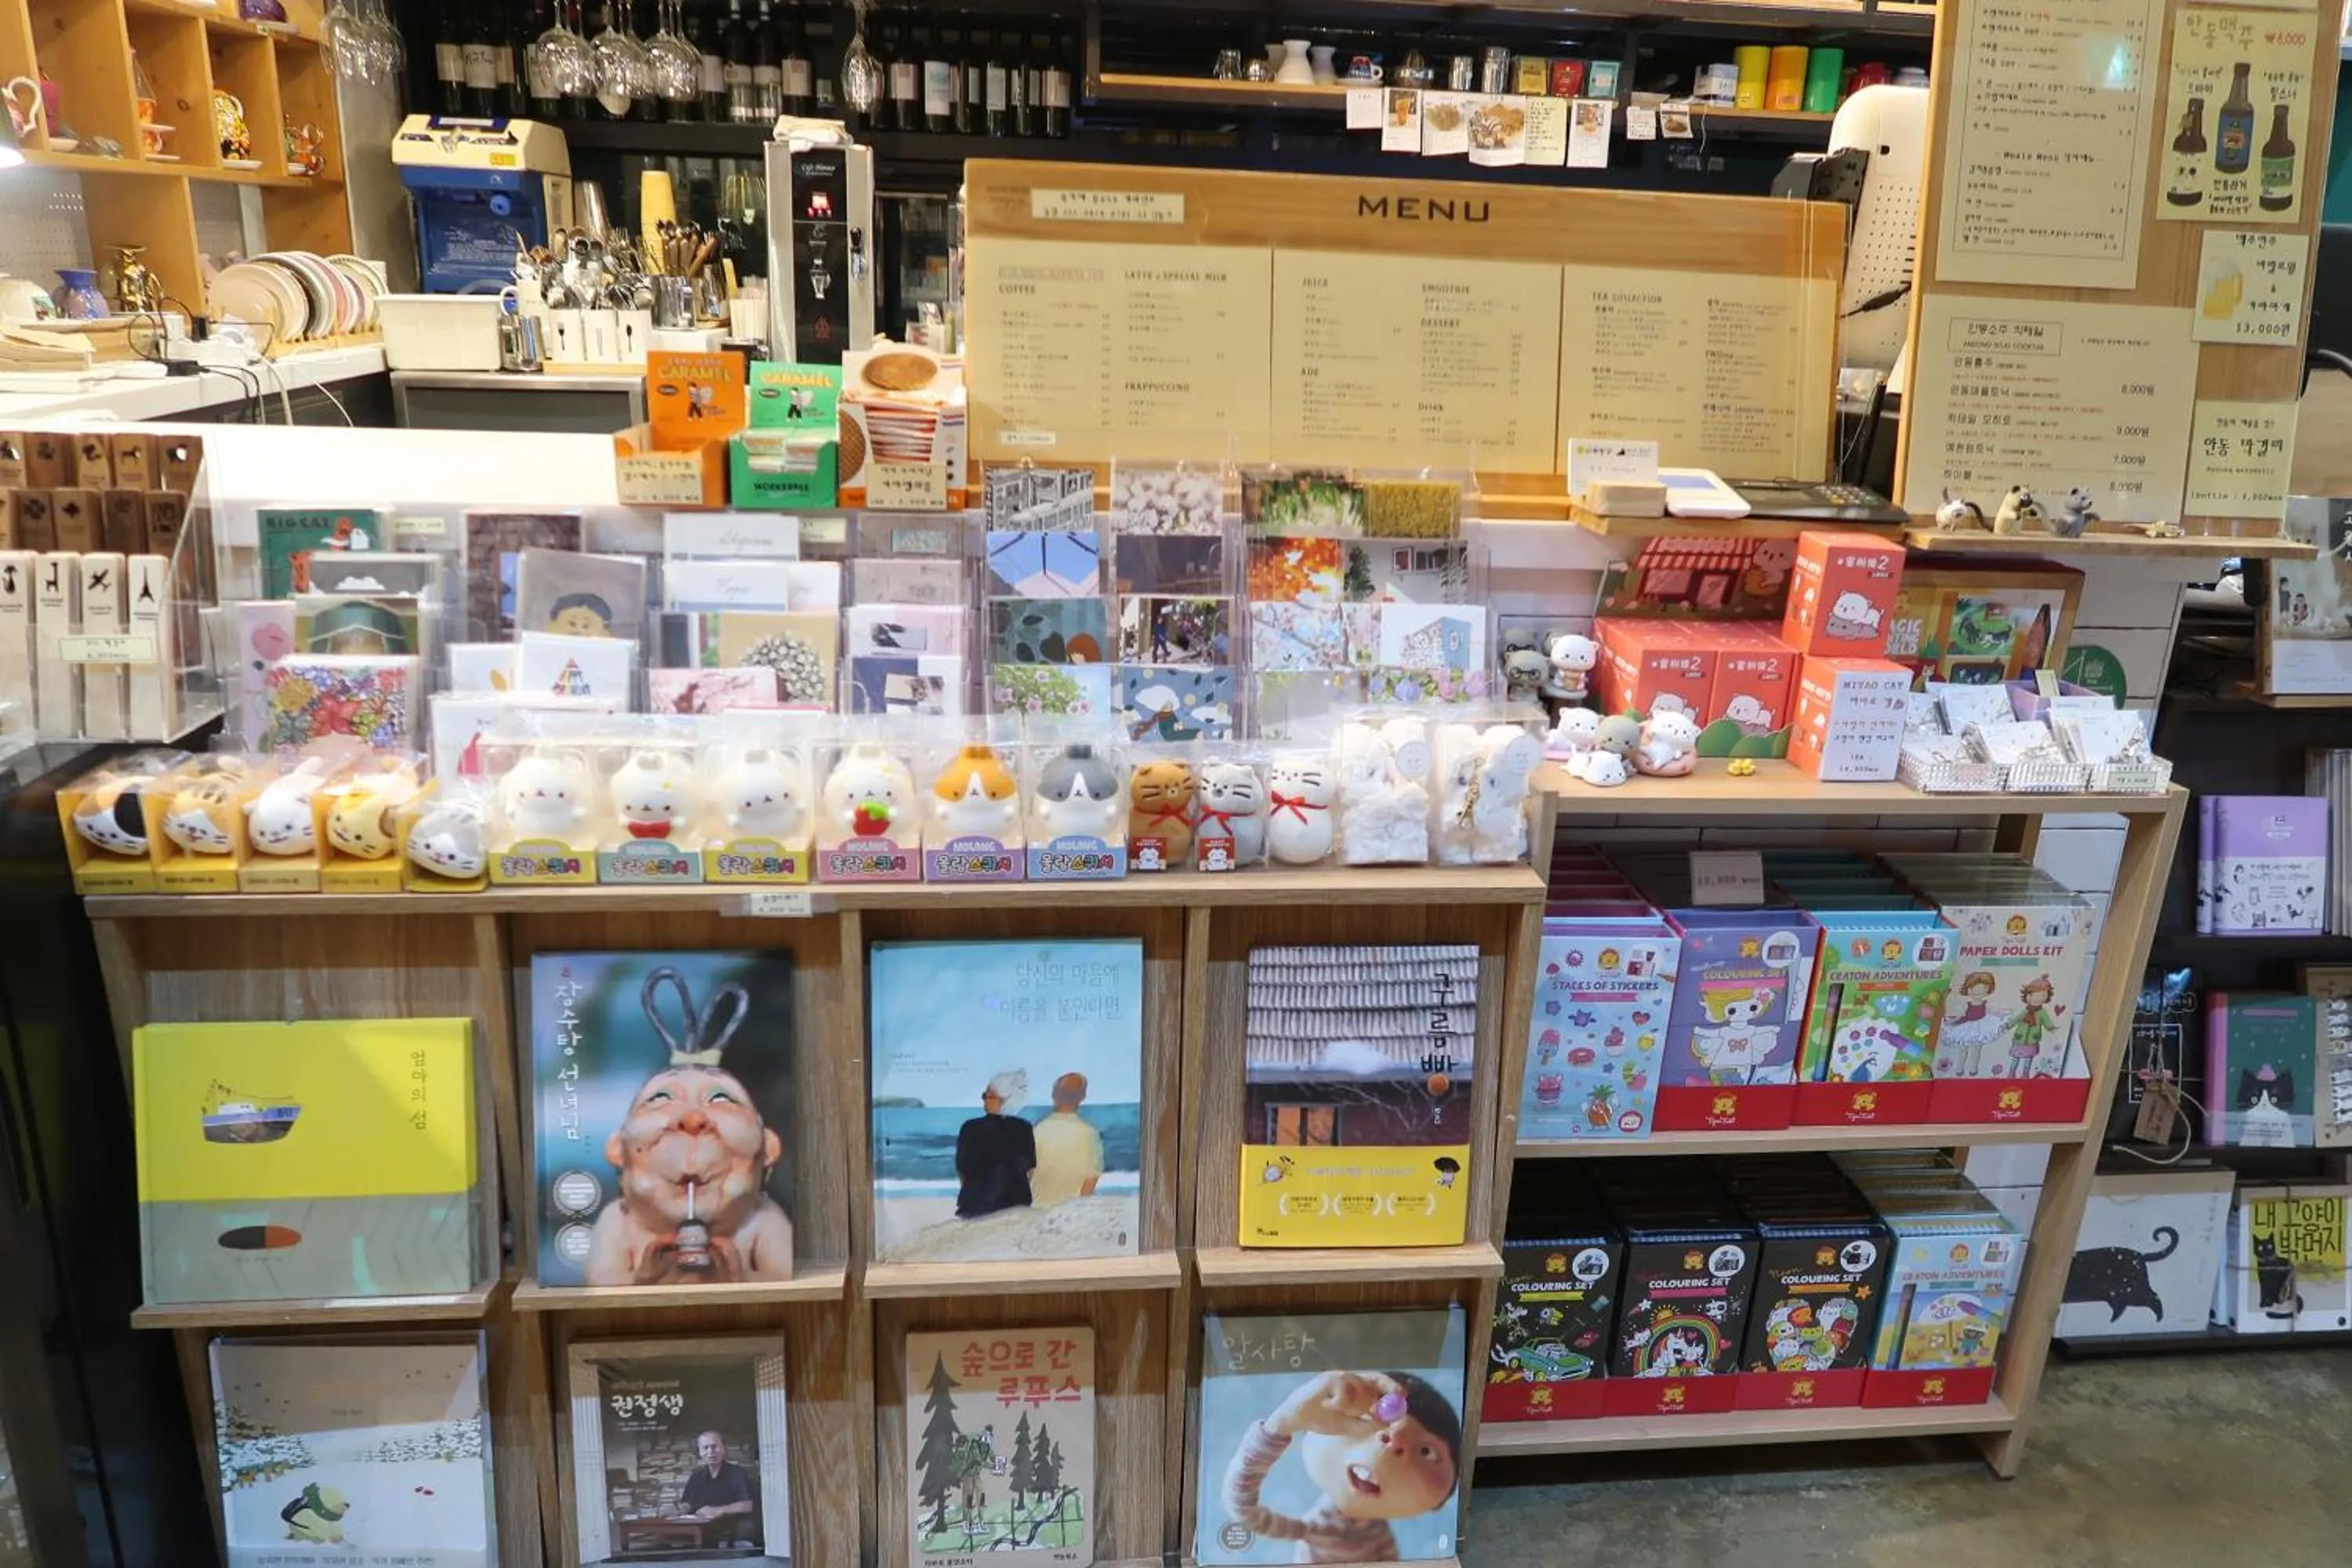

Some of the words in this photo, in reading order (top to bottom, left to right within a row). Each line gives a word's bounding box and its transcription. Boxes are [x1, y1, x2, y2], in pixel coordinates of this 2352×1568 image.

[1358, 194, 1490, 223] MENU
[659, 366, 731, 383] CARAMEL
[759, 372, 834, 387] CARAMEL
[299, 517, 329, 528] CAT
[1959, 946, 1998, 956] PAPER
[2001, 946, 2040, 956] DOLLS
[1072, 960, 1120, 987] 마음에
[1873, 970, 1944, 980] ADVENTURES
[1552, 980, 1592, 990] STACKS
[1593, 980, 1606, 990] OF
[1607, 981, 1659, 991] STICKERS
[554, 980, 583, 1056] 장수탕
[1420, 972, 1460, 1074] 구름빵
[557, 1063, 581, 1141] 선녀님
[408, 1109, 426, 1130] 섬
[2255, 1201, 2276, 1229] 내
[2282, 1196, 2343, 1232] 고양이
[1511, 1281, 1572, 1292] COLOURING
[1573, 1281, 1595, 1290] SET
[1649, 1278, 1708, 1289] COLOURING
[1710, 1277, 1731, 1287] SET
[1781, 1274, 1842, 1284] COLOURING
[1842, 1273, 1863, 1283] SET
[960, 1340, 1035, 1378] 숲으로
[1047, 1340, 1077, 1370] 간
[1222, 1331, 1316, 1371] 알사탕
[996, 1375, 1082, 1409] 루푸스
[610, 1393, 684, 1417] 권정생
